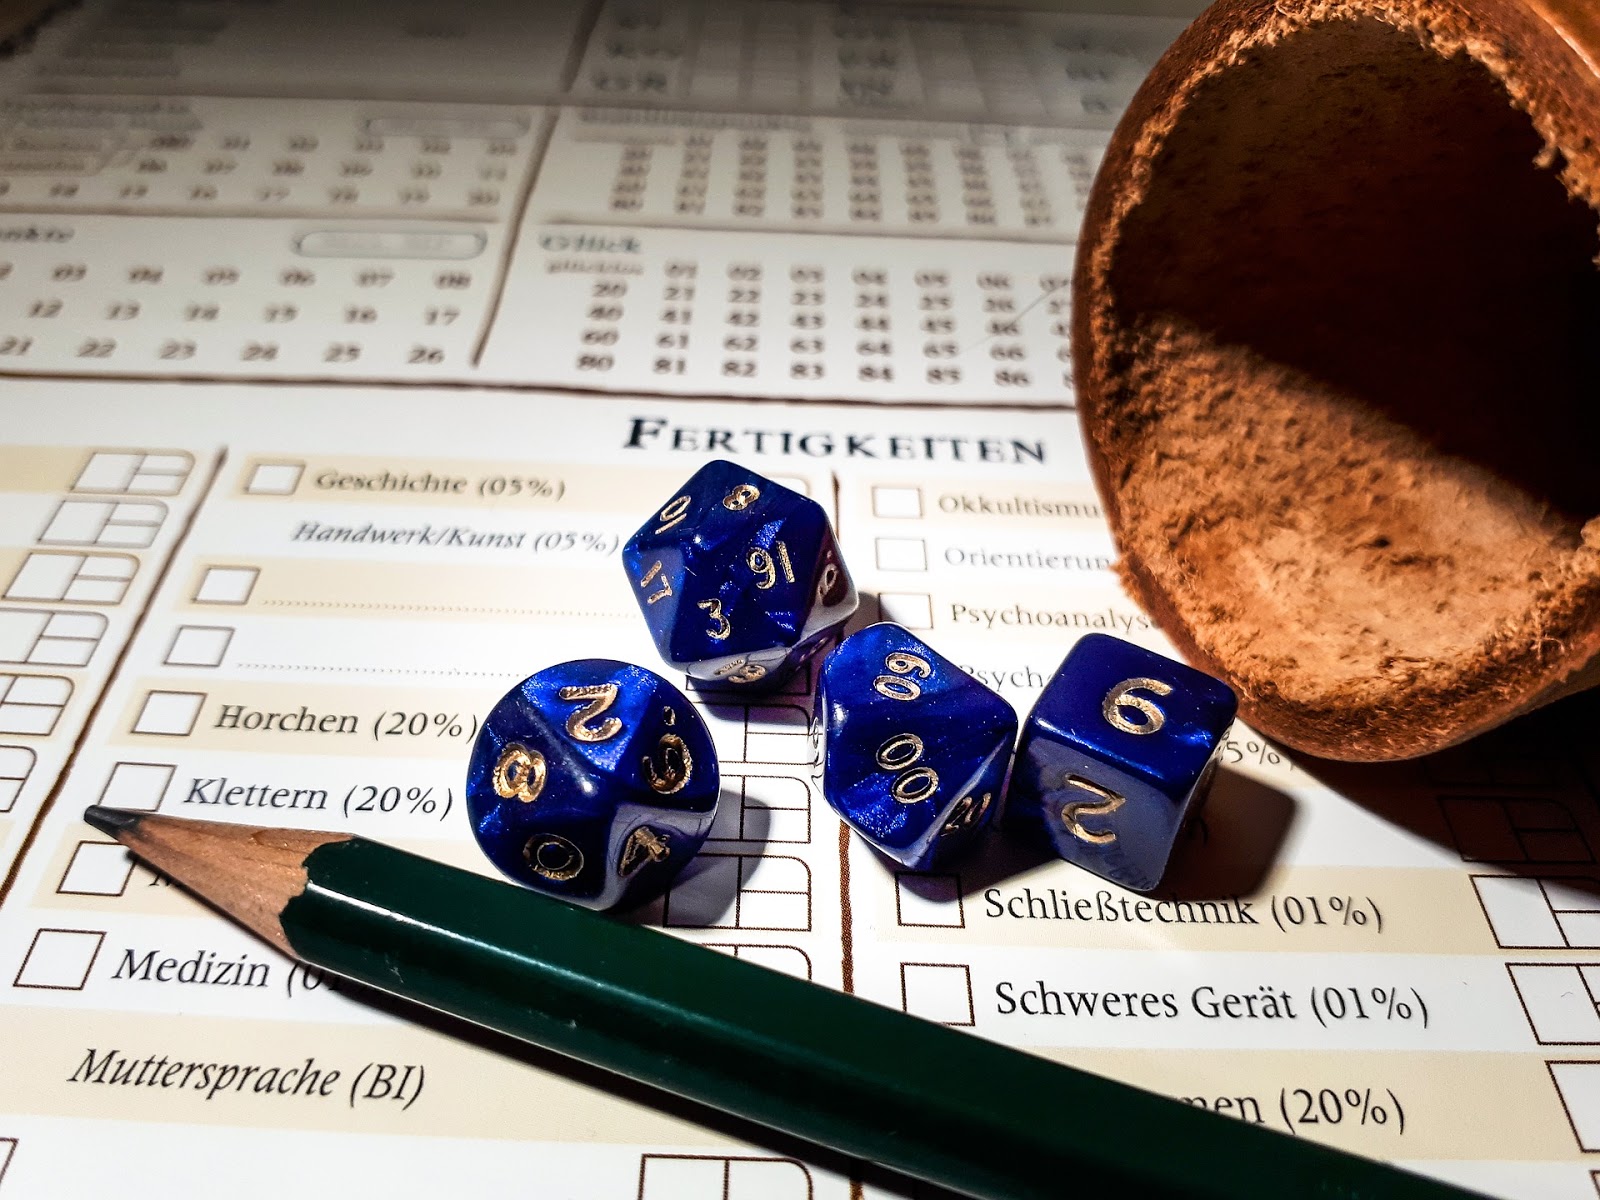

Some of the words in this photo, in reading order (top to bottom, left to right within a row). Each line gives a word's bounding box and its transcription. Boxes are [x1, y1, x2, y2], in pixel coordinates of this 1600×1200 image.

[29, 300, 63, 318] 12
[106, 301, 140, 320] 13
[425, 306, 460, 325] 17
[0, 337, 33, 356] 21
[76, 338, 116, 358] 22
[159, 339, 197, 360] 23
[241, 342, 279, 361] 24
[324, 343, 361, 362] 25
[408, 346, 444, 363] 26
[654, 331, 691, 350] 61
[721, 333, 760, 352] 62
[575, 352, 616, 371] 80
[652, 356, 688, 375] 81
[720, 359, 758, 378] 82
[788, 361, 826, 380] 83
[621, 415, 1047, 465] FERTIGKEITEN
[314, 471, 467, 493] Geschichte
[477, 477, 565, 500] (05%)
[722, 484, 761, 511] 8
[936, 488, 1099, 520] Okkultismu
[292, 521, 525, 548] Handwerk/Kunst
[532, 529, 619, 557] (05%)
[944, 545, 1110, 572] Orientierun
[696, 598, 731, 641] 3
[948, 600, 1152, 636] Psychoanalys
[958, 663, 1050, 693] sych
[214, 705, 358, 733] Horchen
[372, 708, 479, 745] (20%)
[558, 683, 623, 742] 2
[1101, 677, 1175, 736] 6
[492, 742, 547, 803] 8
[875, 732, 940, 805] 00
[183, 778, 328, 809] Klettern
[343, 786, 452, 821] (20%)
[1061, 772, 1127, 845] 2
[522, 832, 585, 882] 0
[618, 825, 671, 878] 4
[985, 887, 1260, 927] Schließtechnik
[1269, 893, 1384, 935] (01%)
[112, 948, 271, 988] Medizin
[996, 981, 1178, 1018] Schweres
[1191, 986, 1297, 1019] Gerät
[1311, 987, 1428, 1029] (01%)
[67, 1049, 341, 1100] Muttersprache
[350, 1063, 424, 1110] (BI)
[1279, 1088, 1405, 1136] (20%)
